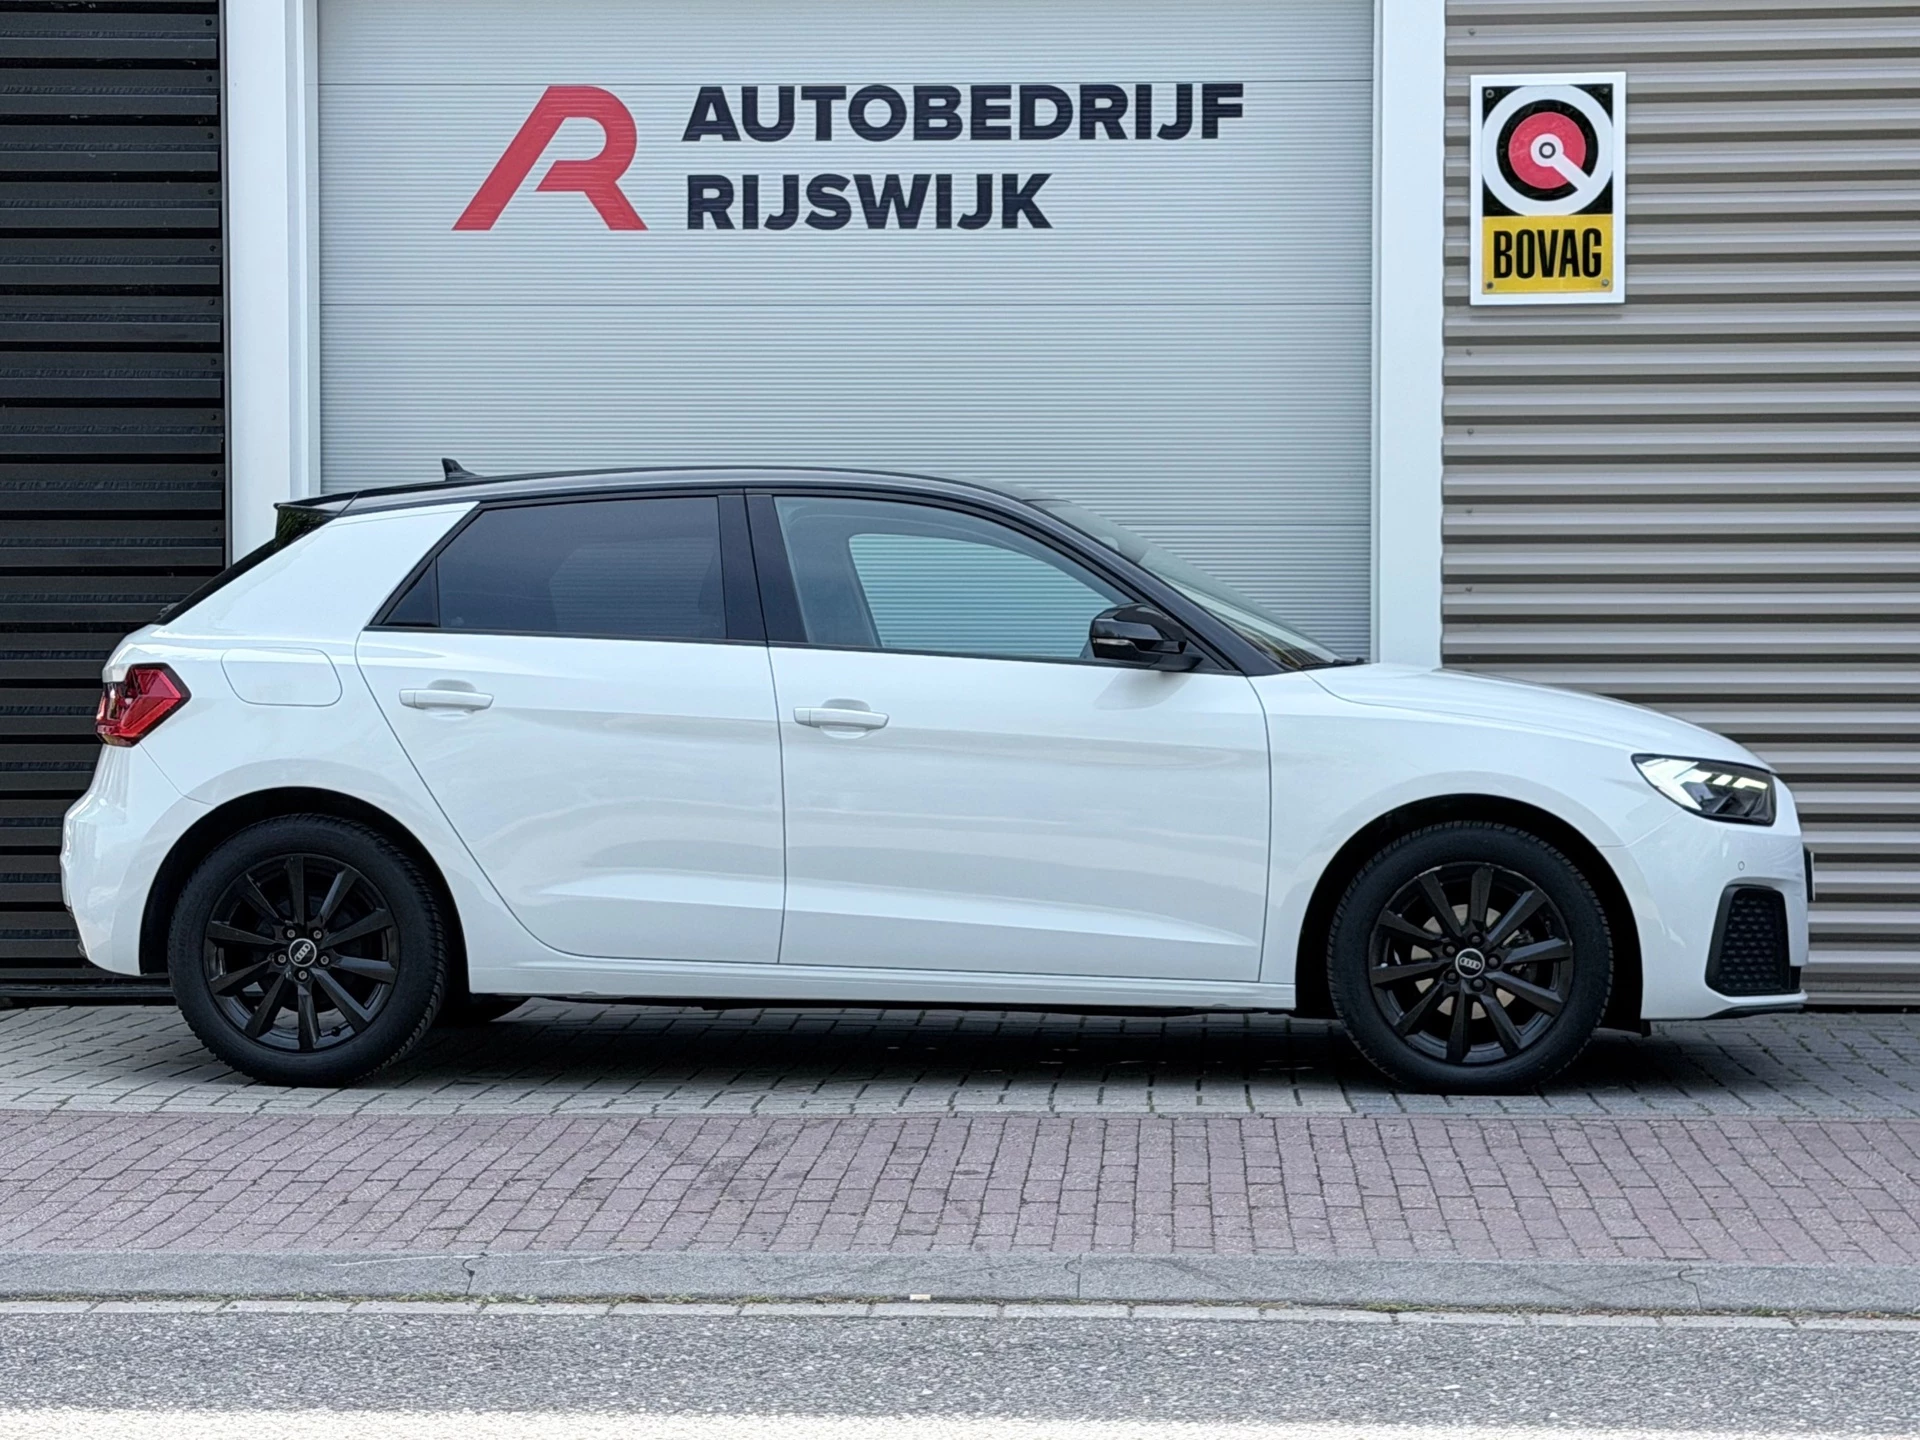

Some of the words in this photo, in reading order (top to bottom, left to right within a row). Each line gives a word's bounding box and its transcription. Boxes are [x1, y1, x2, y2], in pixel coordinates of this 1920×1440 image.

[683, 83, 1243, 141] AUTOBEDRIJF
[687, 173, 1052, 231] RIJSWIJK
[1494, 228, 1602, 279] BOVAG
